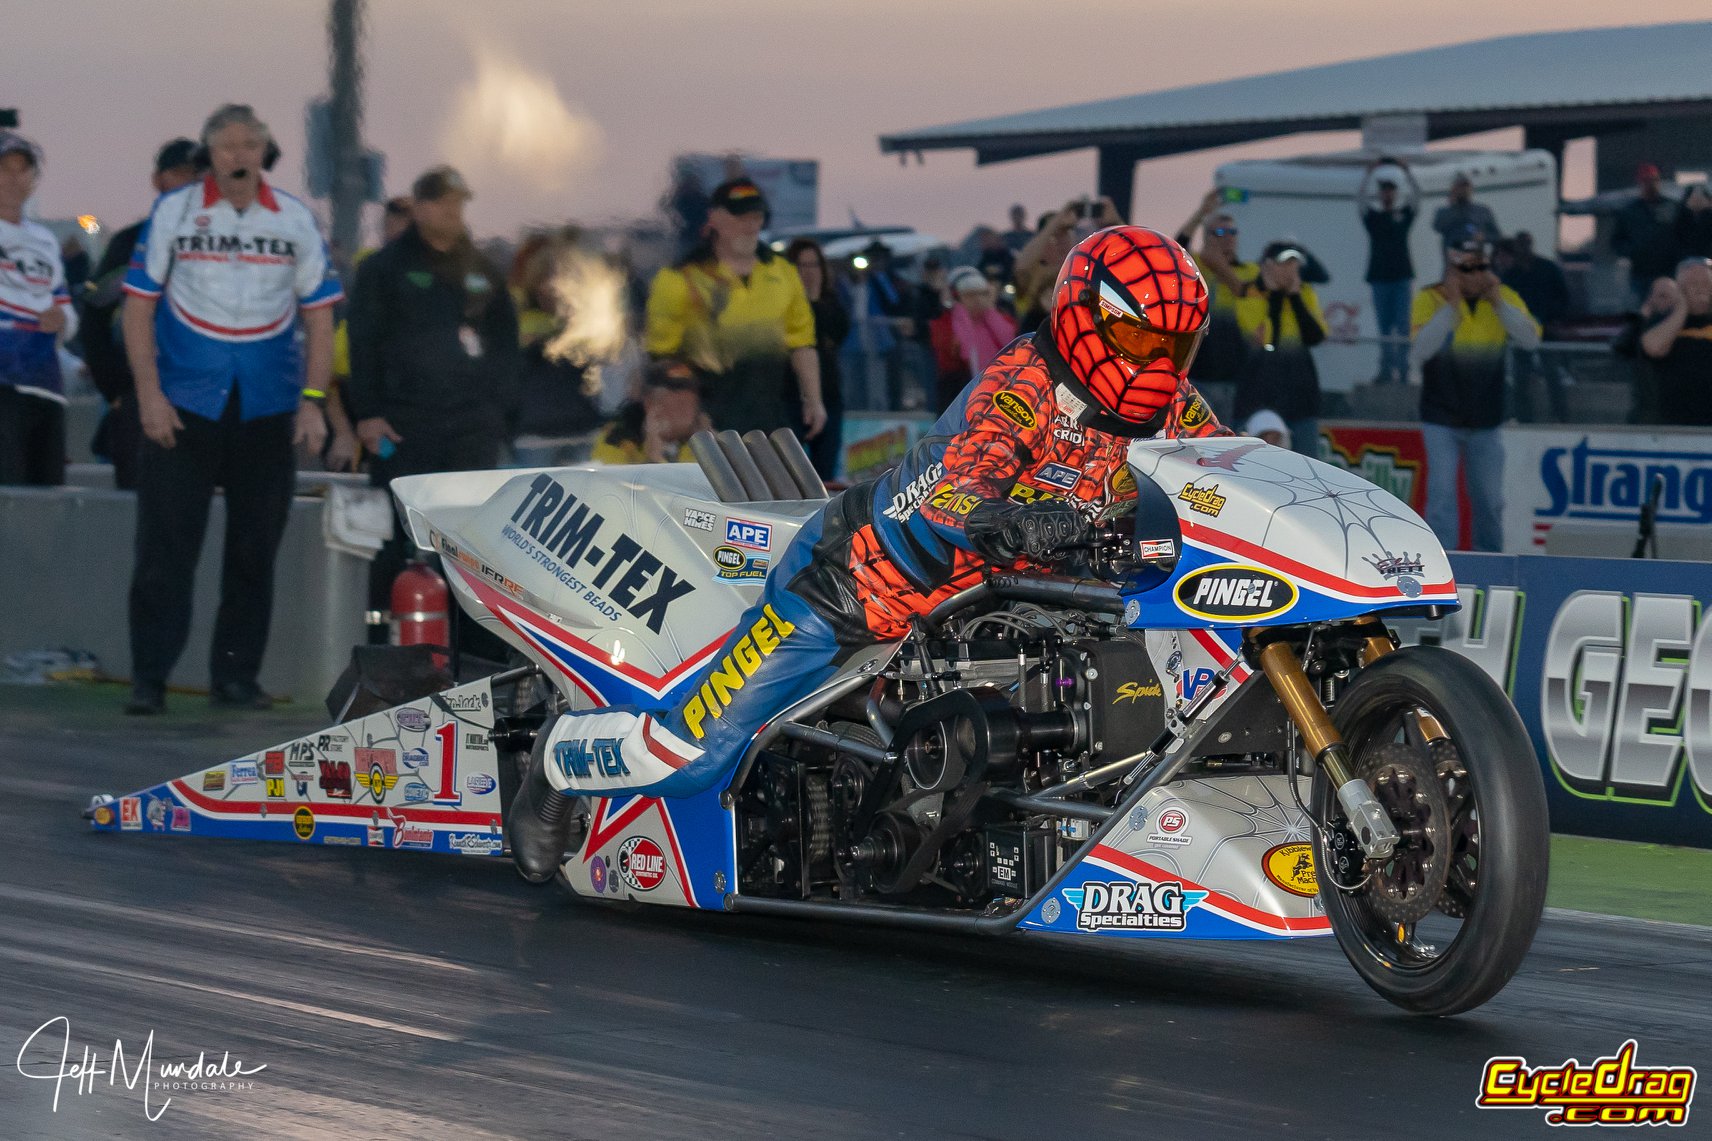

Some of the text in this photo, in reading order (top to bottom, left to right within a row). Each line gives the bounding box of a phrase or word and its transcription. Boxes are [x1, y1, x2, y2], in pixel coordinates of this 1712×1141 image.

[176, 234, 296, 257] TRIM-TEX
[728, 524, 767, 545] APE
[510, 473, 696, 635] TRIM-TEX
[717, 550, 741, 566] PINGEL
[1143, 545, 1172, 553] CHAMPION
[501, 523, 623, 622] WORLD'S STRONGEST BEADS
[721, 570, 738, 578] TOP
[1193, 578, 1275, 608] PINGEL
[682, 603, 796, 741] PINGEL
[433, 720, 463, 807] 1
[1163, 817, 1181, 827] PS
[632, 853, 664, 873] RED LINE
[1082, 884, 1183, 914] DRAG
[1080, 912, 1183, 927] Specialties
